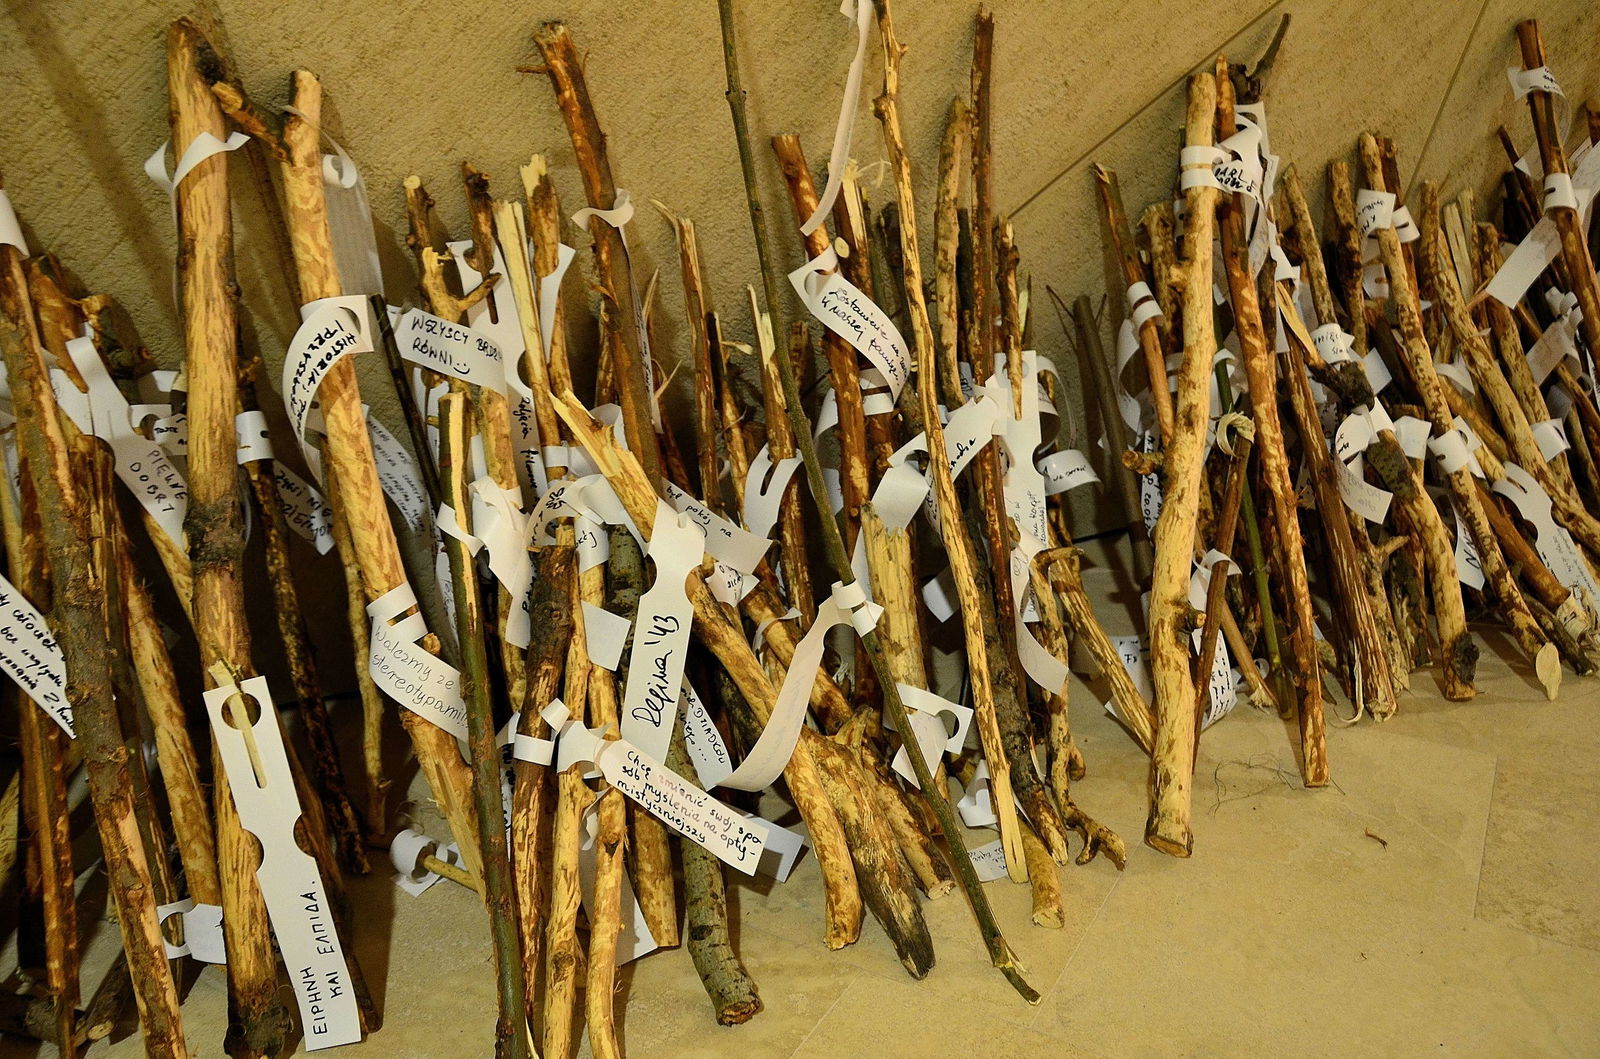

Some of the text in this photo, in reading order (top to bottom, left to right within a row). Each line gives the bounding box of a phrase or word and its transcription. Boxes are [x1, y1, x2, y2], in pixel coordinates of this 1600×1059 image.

[411, 315, 469, 344] WSZYSCY
[685, 505, 711, 525] pokój
[720, 528, 732, 538] na
[375, 625, 455, 690] Walczmy ze
[644, 615, 680, 645] '43
[617, 779, 706, 844] mistyczniejszy
[621, 766, 641, 781] sób
[645, 782, 700, 822] myślenia
[703, 820, 718, 835] na
[627, 750, 652, 781] Chcę
[709, 809, 736, 833] swój
[737, 826, 763, 844] spo
[299, 966, 328, 1035] ΕΙΡΗΝΗ
[325, 971, 343, 999] ΚΑΙ
